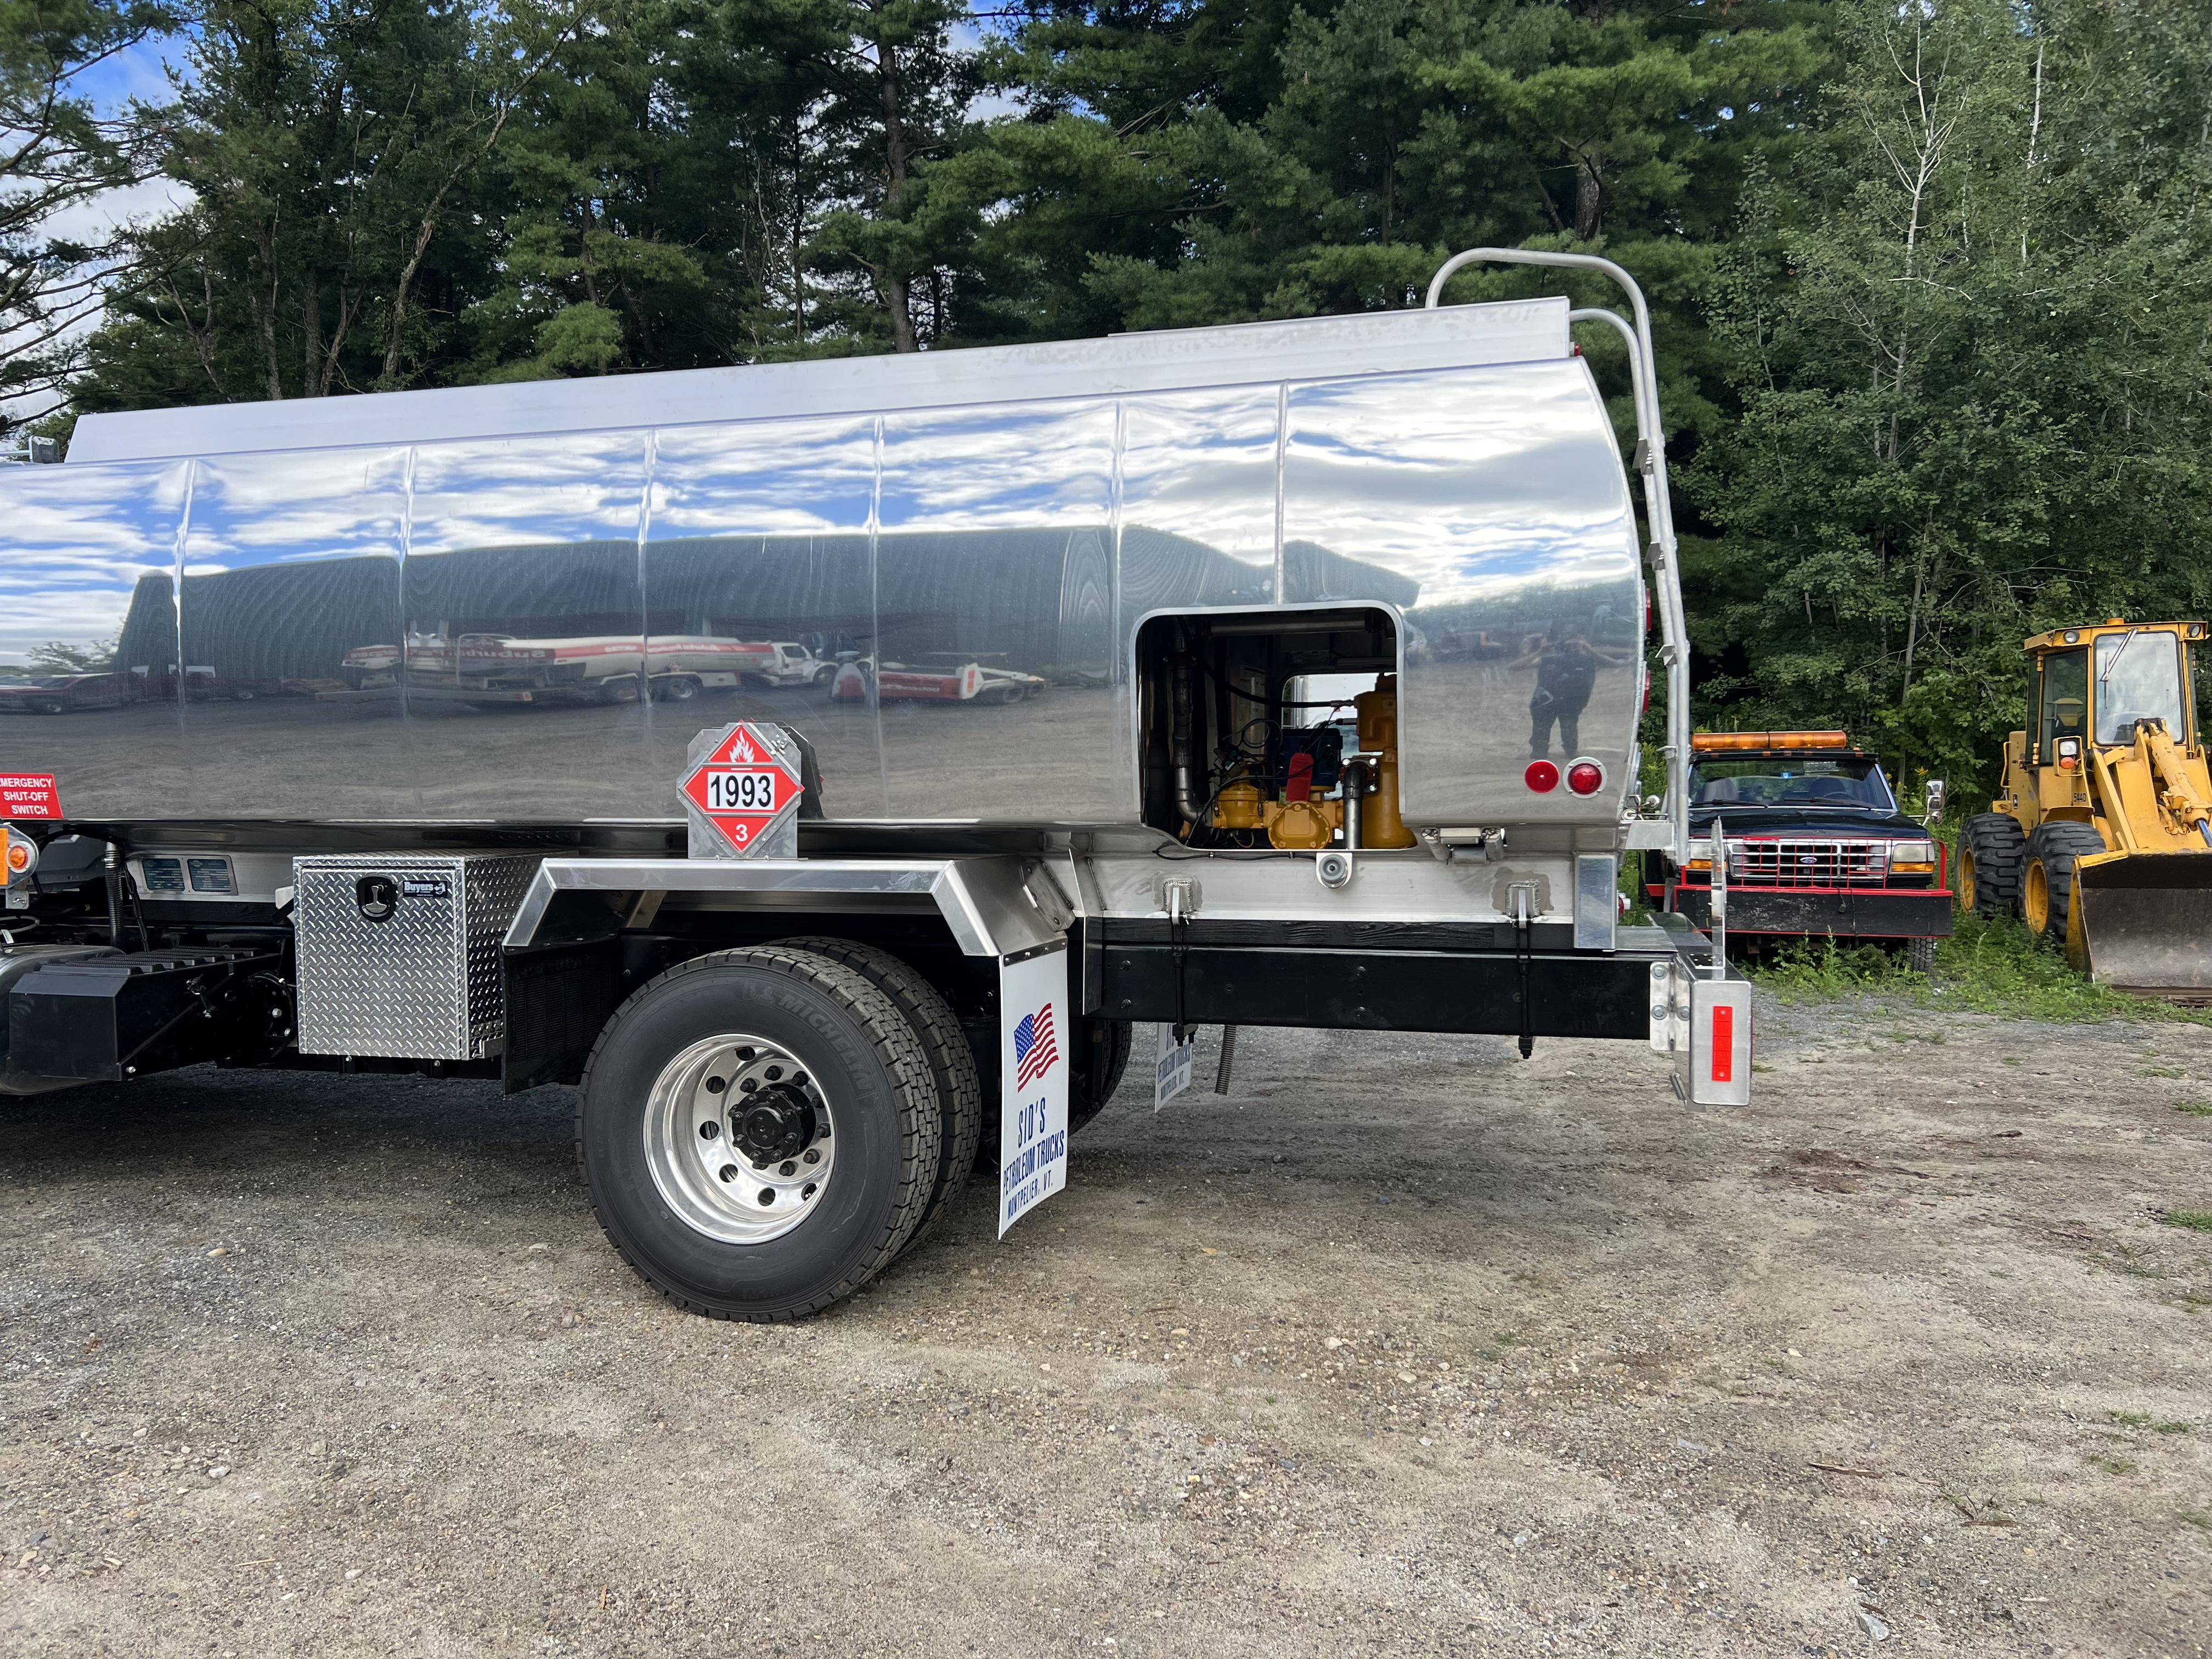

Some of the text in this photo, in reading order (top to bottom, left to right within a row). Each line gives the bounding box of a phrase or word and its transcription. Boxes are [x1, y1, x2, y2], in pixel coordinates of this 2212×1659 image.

[0, 777, 52, 788] MERGENCY
[710, 775, 771, 808] 1993
[3, 791, 49, 802] SHUT-OFF
[2074, 792, 2086, 803] 544D
[11, 804, 48, 815] SWITCH
[735, 823, 748, 842] 3
[404, 881, 434, 893] Buyers
[778, 994, 873, 1090] MICHELIN
[1018, 1097, 1046, 1149] SID'S
[1003, 1129, 1065, 1199] PETROLEUM TRUCKS
[1043, 1170, 1053, 1191] VT.
